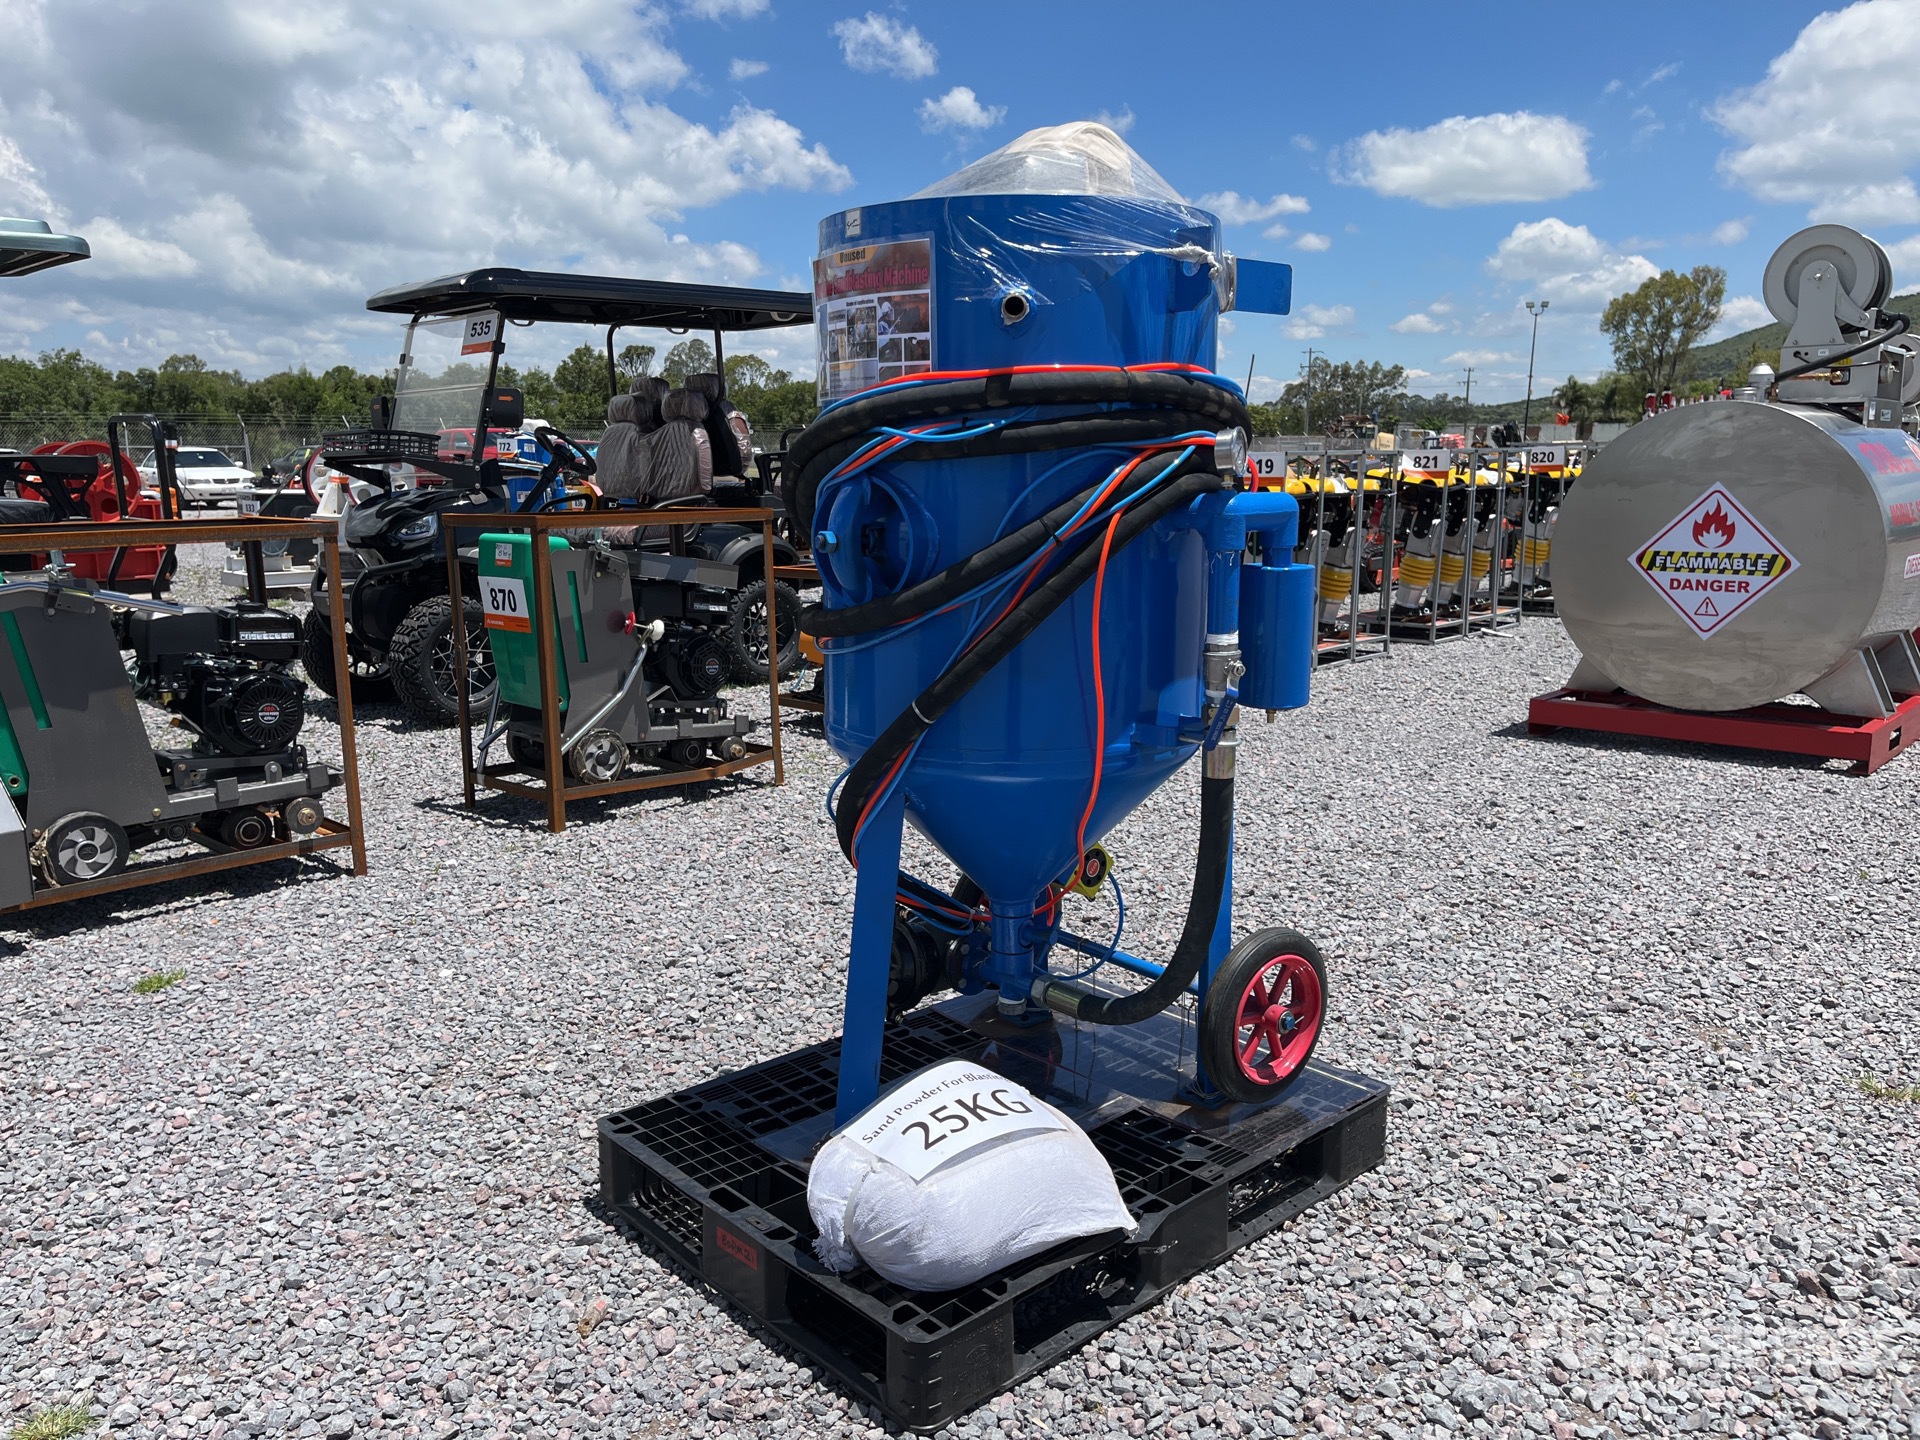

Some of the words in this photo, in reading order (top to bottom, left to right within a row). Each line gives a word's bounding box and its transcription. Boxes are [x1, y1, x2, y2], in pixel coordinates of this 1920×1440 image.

[840, 248, 866, 263] Unused
[884, 262, 929, 287] Machine
[470, 320, 492, 337] 535
[1413, 455, 1438, 468] 821
[1531, 451, 1555, 463] 820
[1246, 459, 1274, 474] 19
[1655, 555, 1769, 571] FLAMMABLE
[1669, 578, 1750, 593] DANGER
[489, 587, 517, 613] 870
[862, 1115, 896, 1144] Sand
[894, 1086, 943, 1116] Powder
[941, 1077, 964, 1088] For
[901, 1089, 1033, 1151] 25KG
